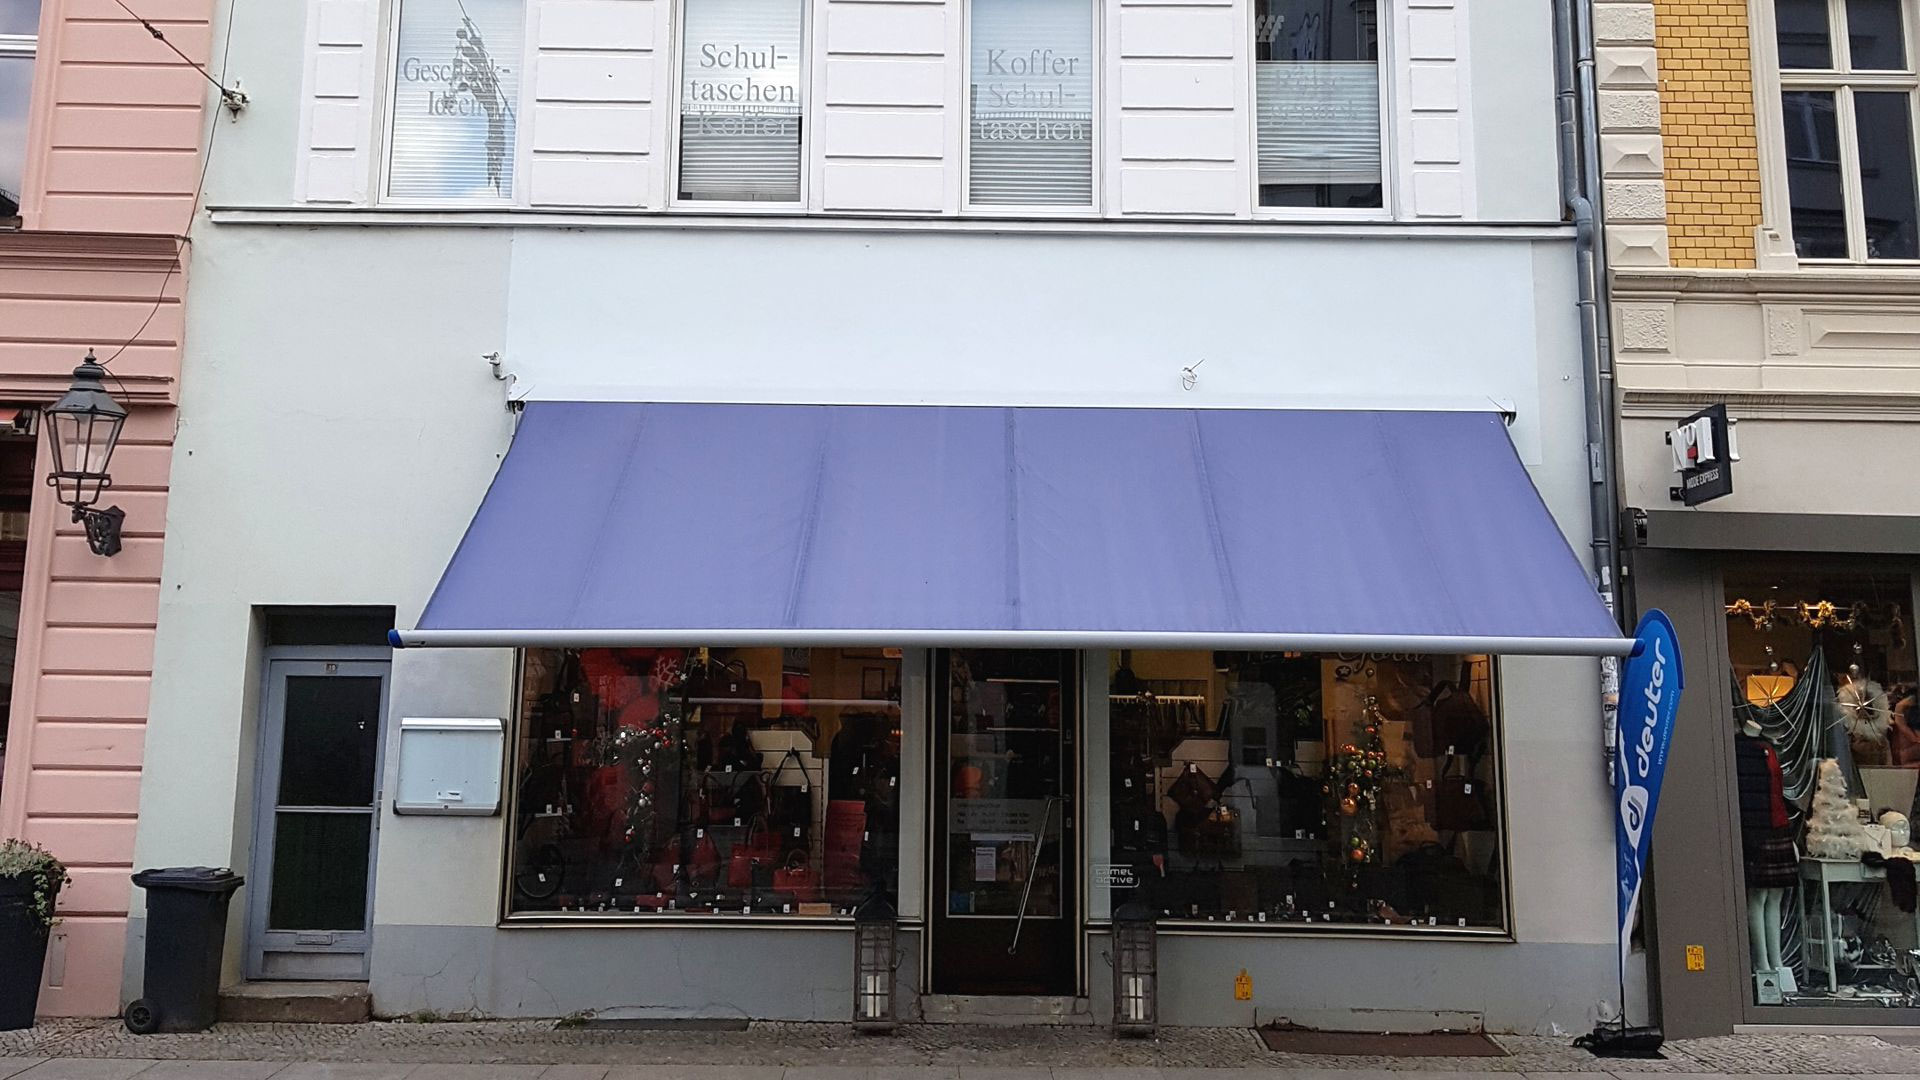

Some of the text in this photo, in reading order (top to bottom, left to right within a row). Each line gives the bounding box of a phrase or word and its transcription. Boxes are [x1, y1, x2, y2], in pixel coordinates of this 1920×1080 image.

[700, 43, 788, 69] Schul-
[984, 49, 1079, 76] Koffer
[691, 77, 795, 102] taschen
[988, 83, 1076, 108] Schul-
[979, 116, 1084, 140] taschen
[1686, 468, 1718, 489] MODE EXPRESS
[1636, 637, 1665, 778] deuter
